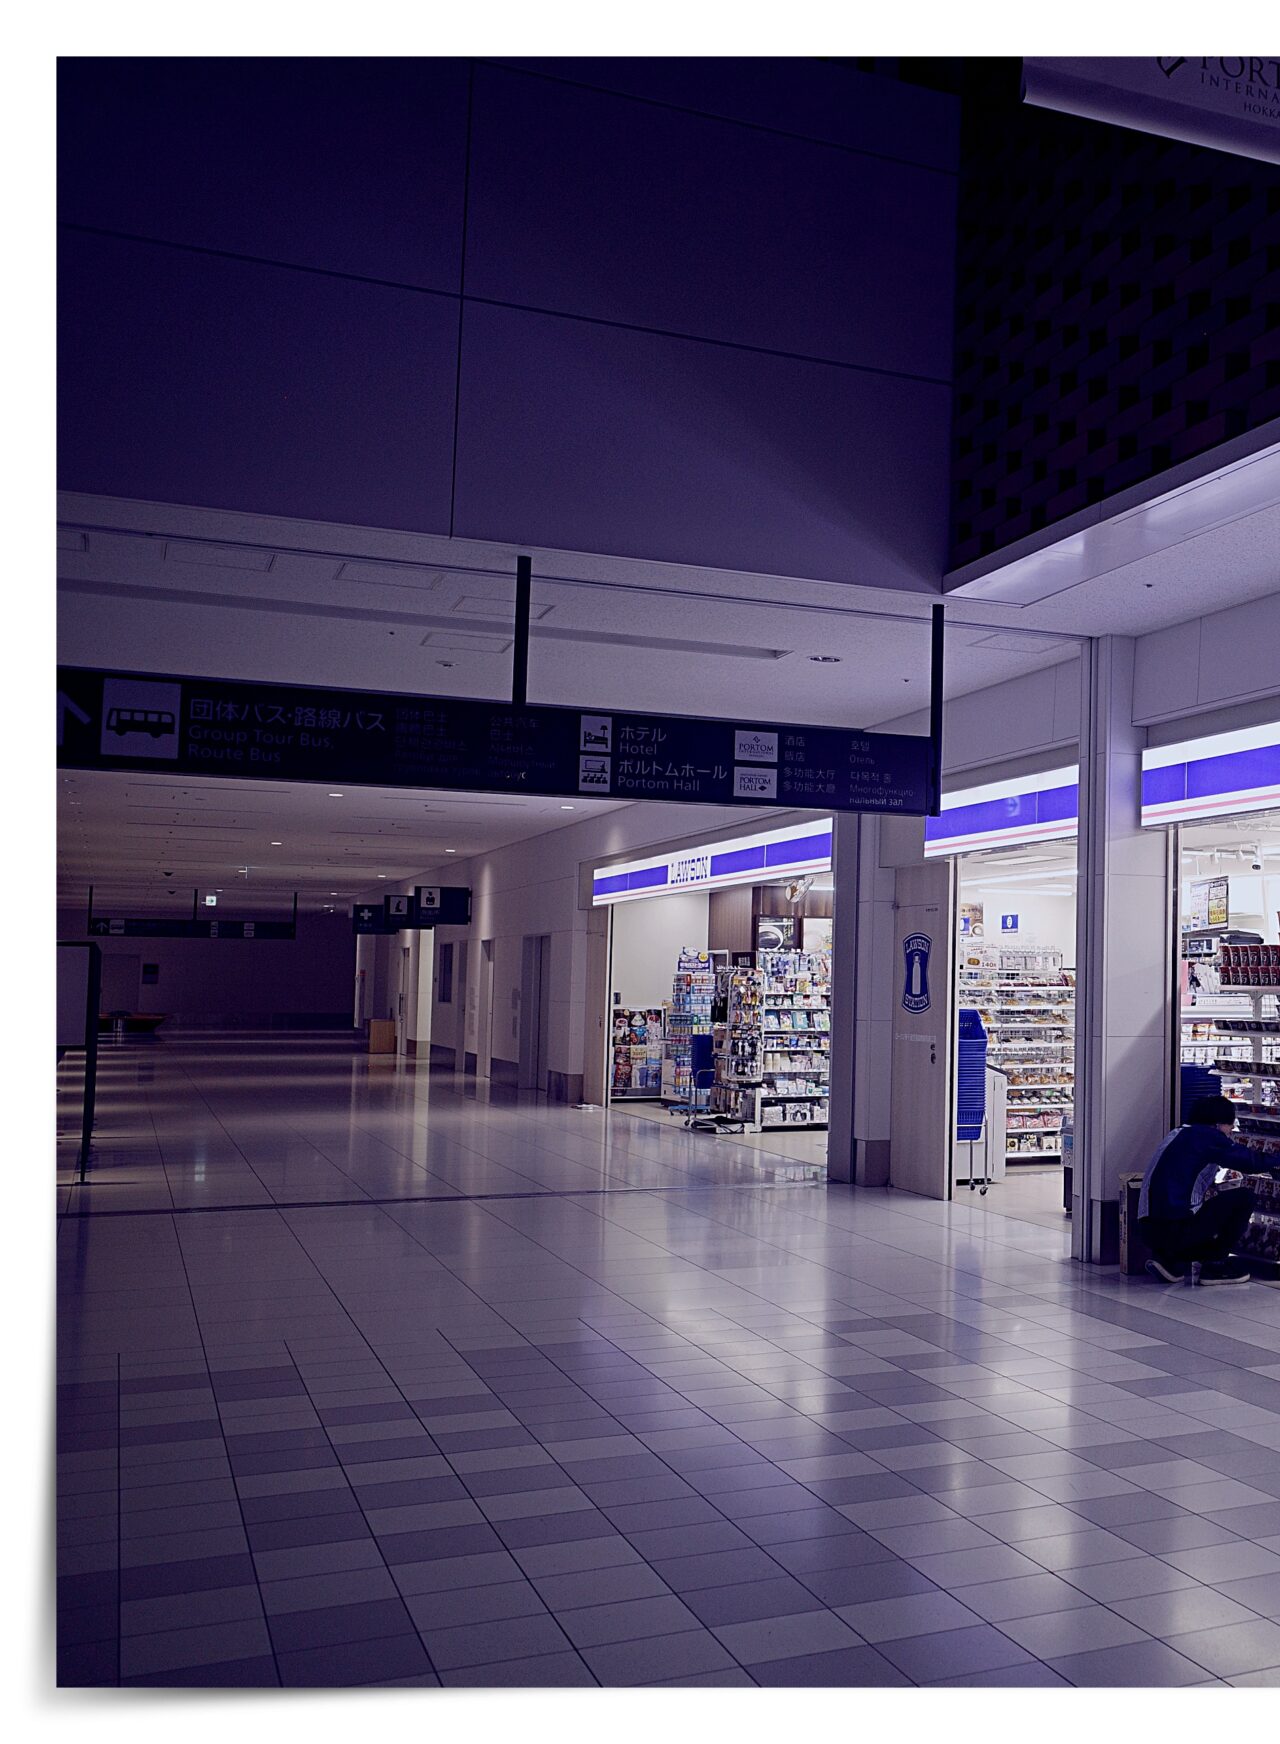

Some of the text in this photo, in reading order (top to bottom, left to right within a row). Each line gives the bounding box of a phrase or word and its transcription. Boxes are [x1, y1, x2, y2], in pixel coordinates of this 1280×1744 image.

[189, 698, 386, 731] 団体バス・路線バス
[188, 725, 248, 745] Group
[253, 728, 294, 745] Tour
[620, 725, 667, 742] ホテル
[784, 736, 806, 747] 酒店
[188, 744, 281, 762] Route Bus
[619, 742, 657, 756] Hotel
[738, 743, 774, 752] PORTOM
[618, 759, 728, 780] ポルトムホール
[783, 767, 837, 780] 多功能大厅
[617, 776, 700, 793] Portom Hall
[739, 776, 771, 785] PORTOM
[671, 856, 708, 884] LAWSON
[905, 938, 929, 954] LAWSON
[905, 993, 928, 1008] STATION
